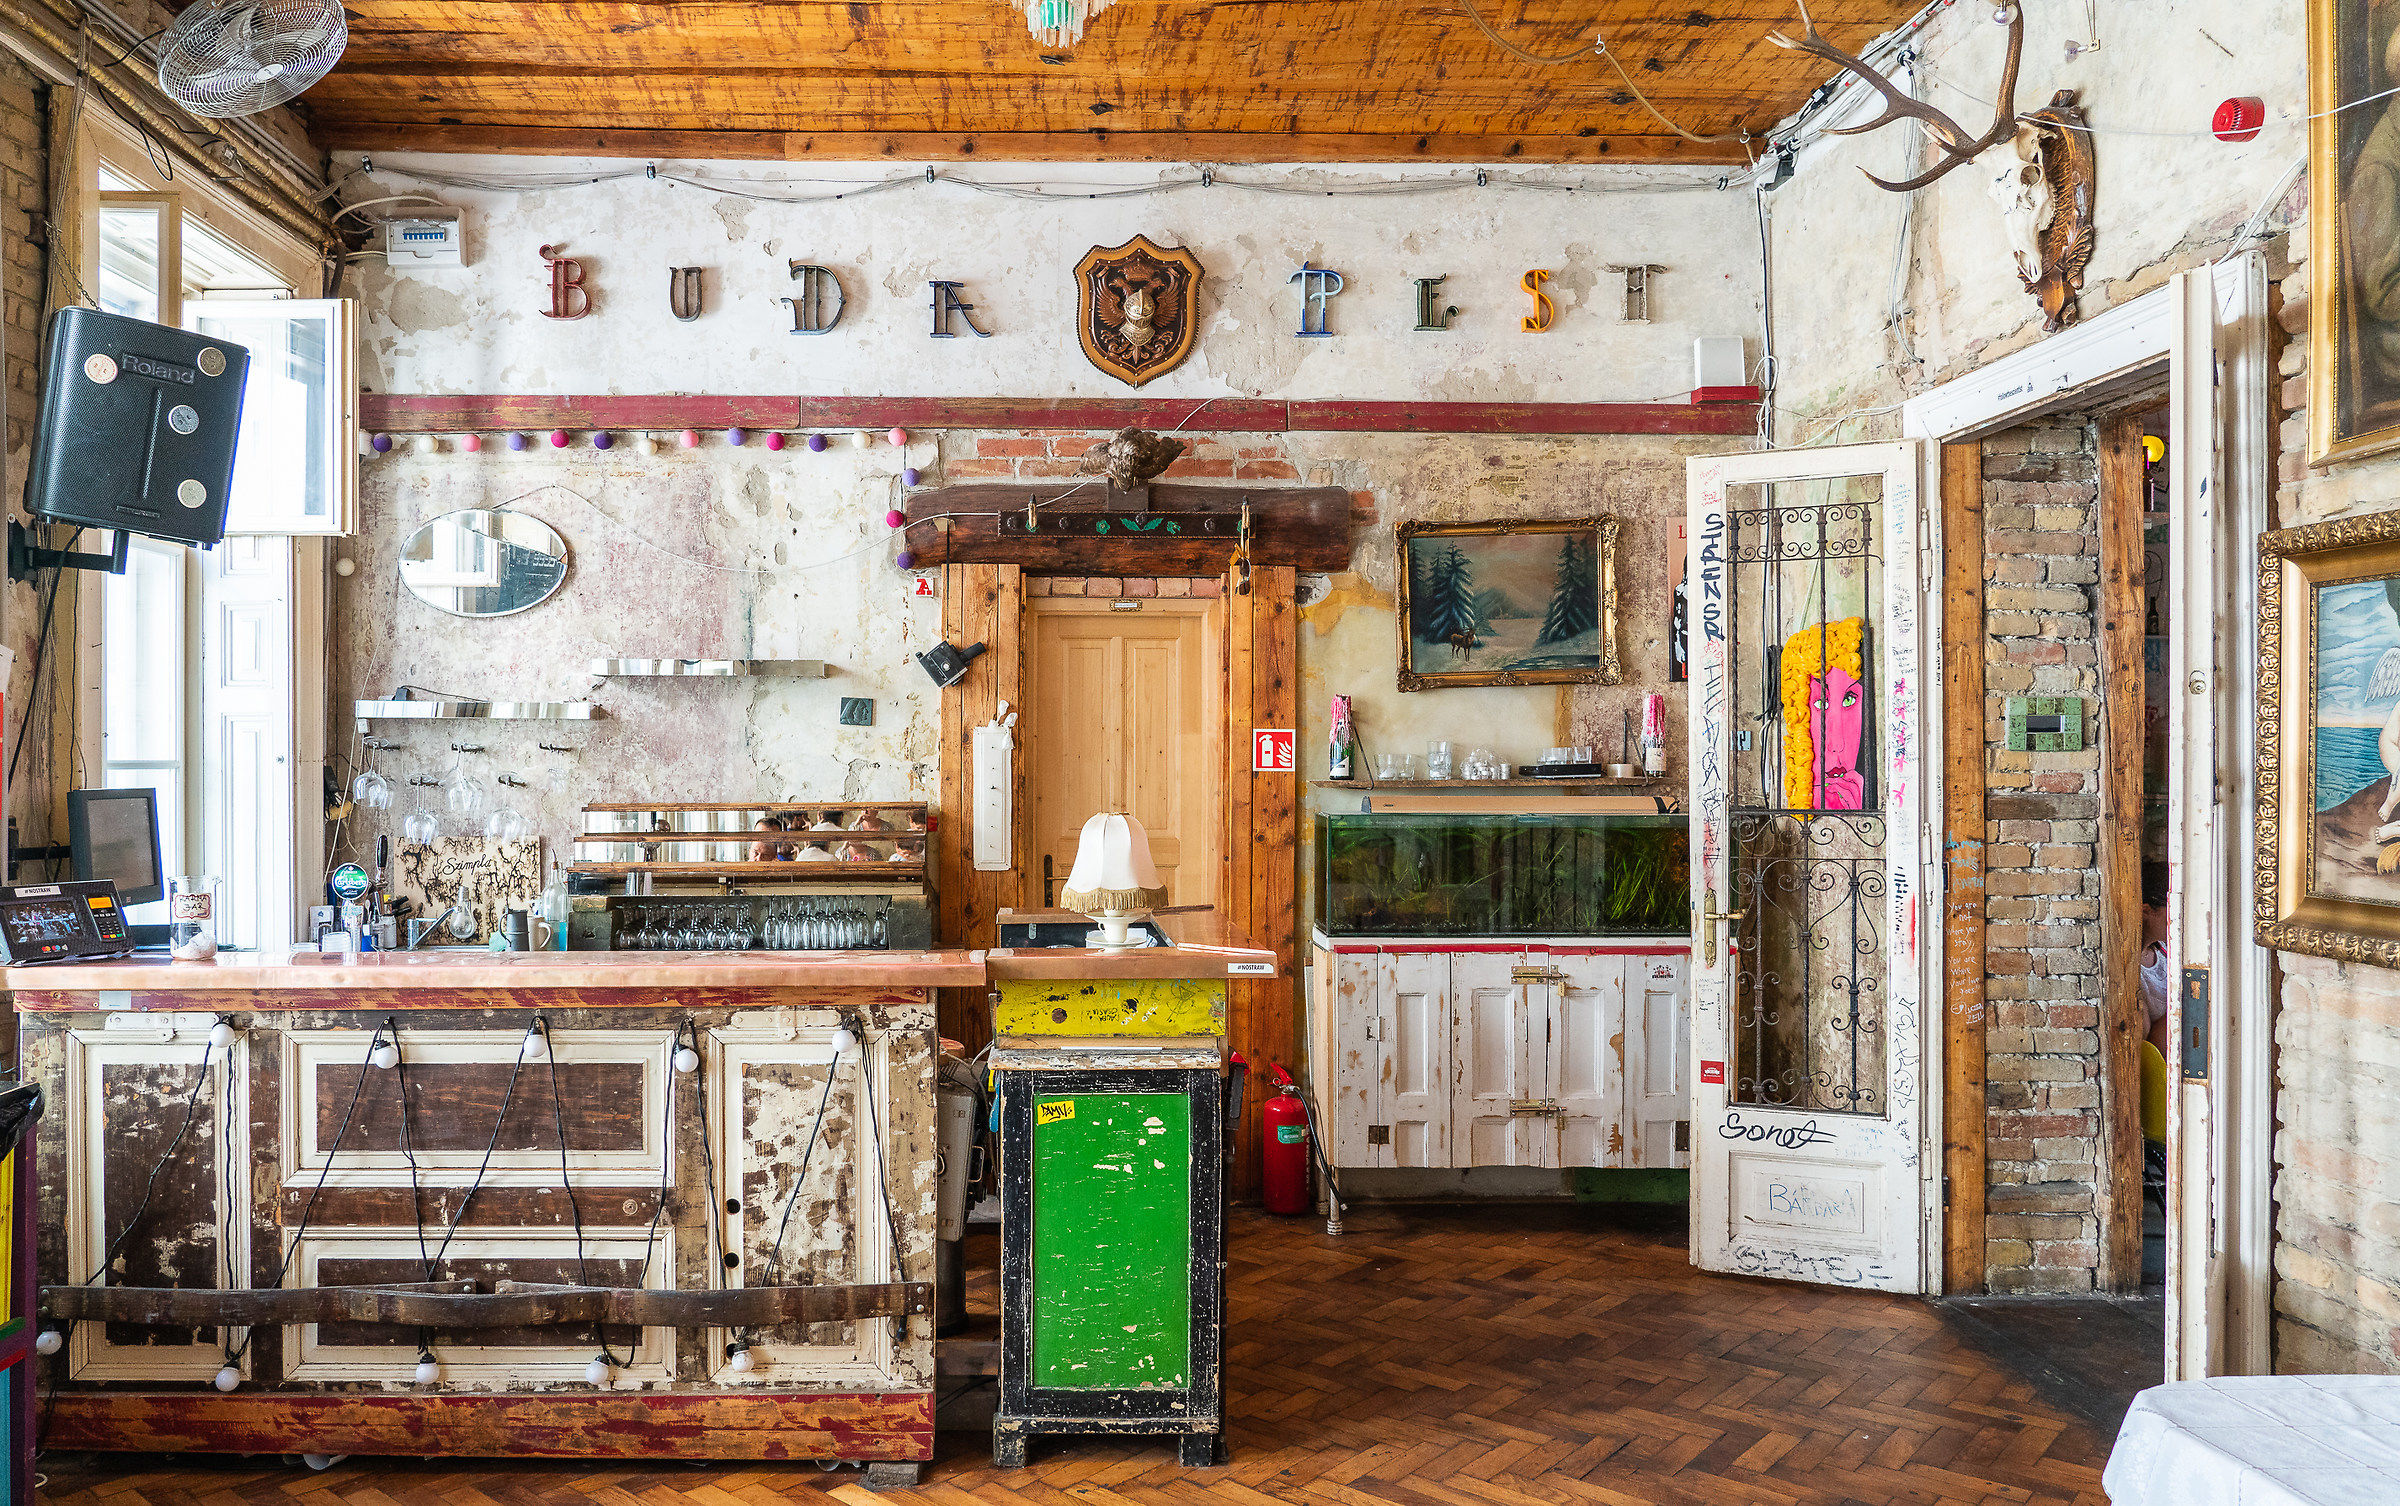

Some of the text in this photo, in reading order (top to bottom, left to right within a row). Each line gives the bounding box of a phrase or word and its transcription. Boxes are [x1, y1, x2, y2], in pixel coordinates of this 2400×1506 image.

[121, 352, 196, 385] Roland
[915, 578, 933, 596] A
[442, 853, 492, 876] Szimpla
[335, 875, 367, 889] Carlsberg
[1958, 911, 1972, 922] not
